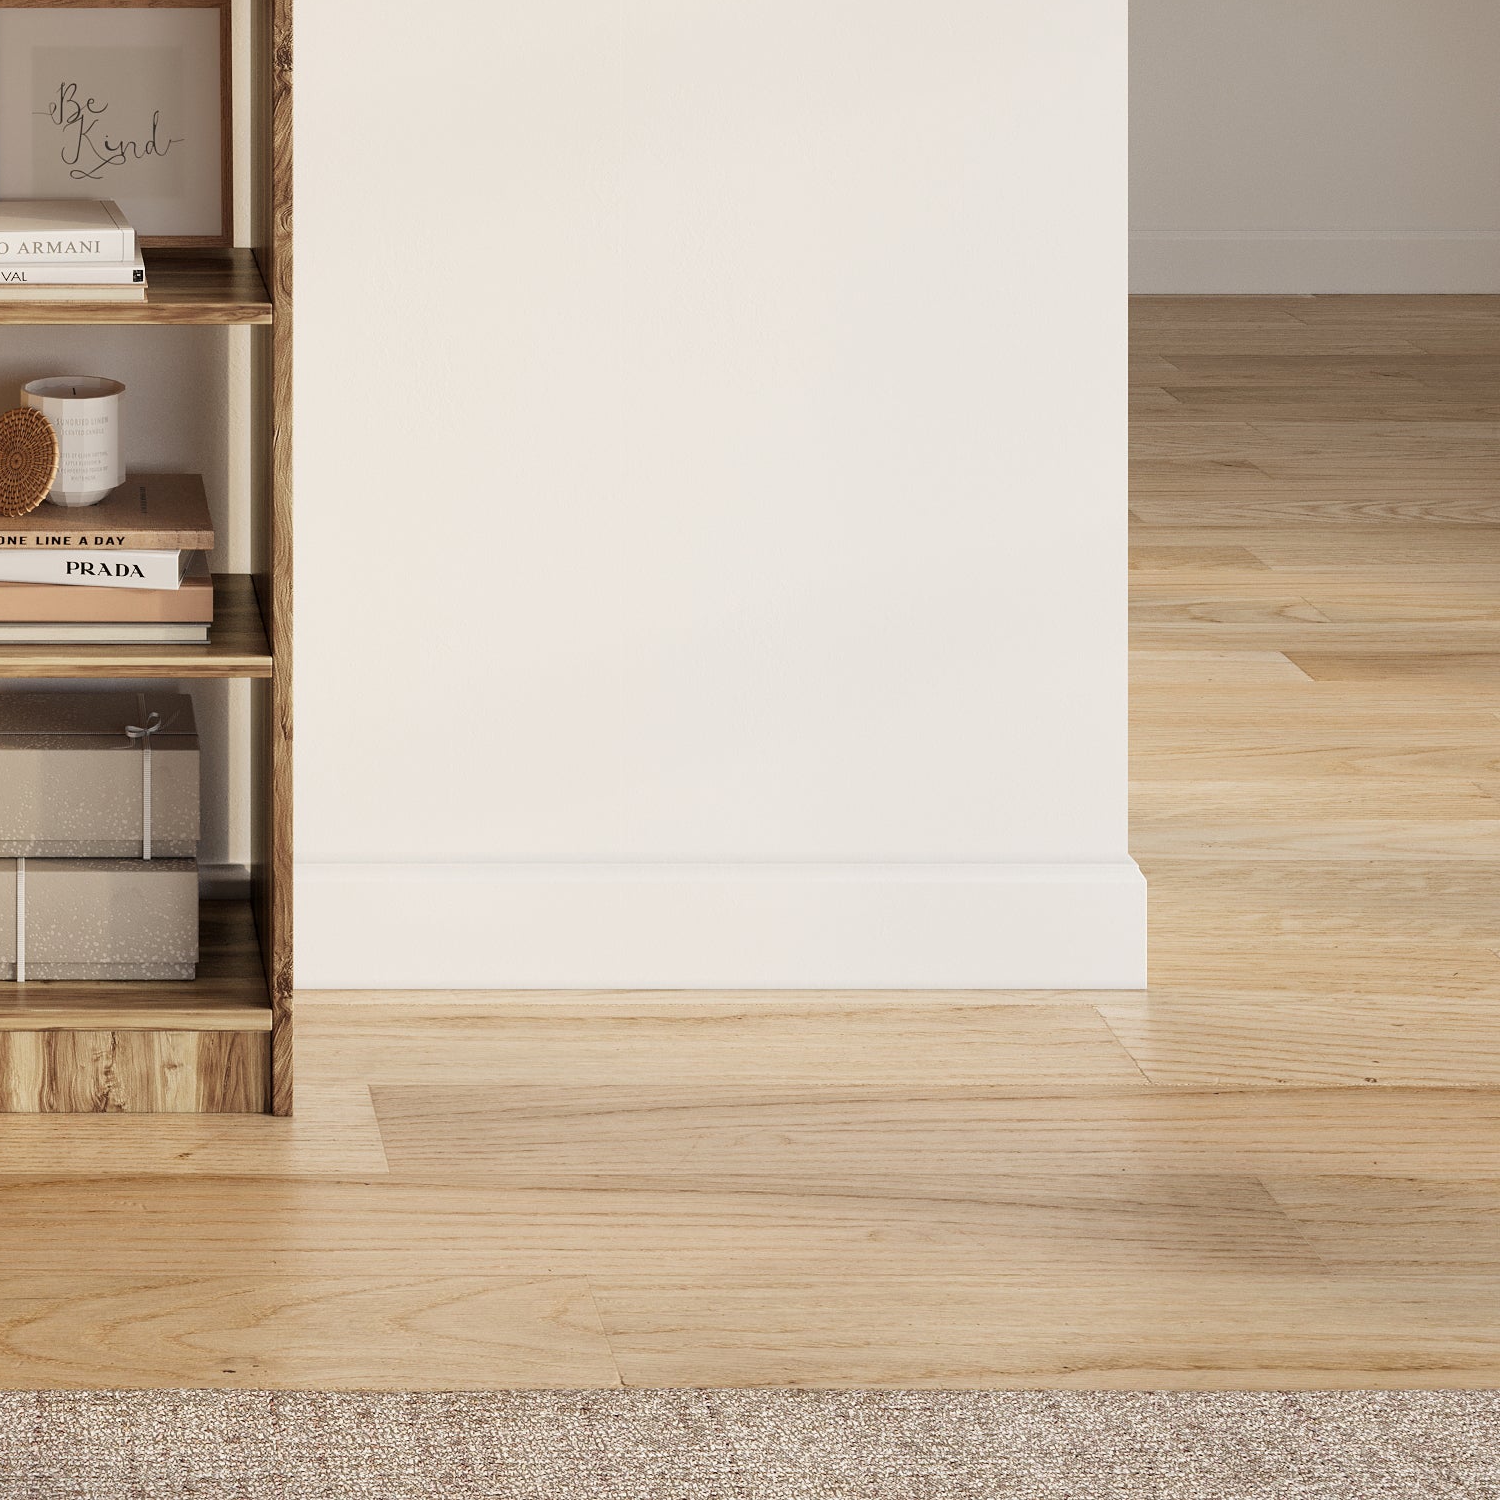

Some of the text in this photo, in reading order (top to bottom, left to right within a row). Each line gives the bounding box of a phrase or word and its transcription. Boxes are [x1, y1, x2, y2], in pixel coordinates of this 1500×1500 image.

[32, 81, 108, 125] Be
[61, 110, 185, 179] Kind
[17, 240, 101, 255] ARMANI
[36, 535, 71, 546] LINE
[78, 535, 89, 546] A
[94, 535, 126, 546] DAY
[66, 561, 145, 578] PRADA
